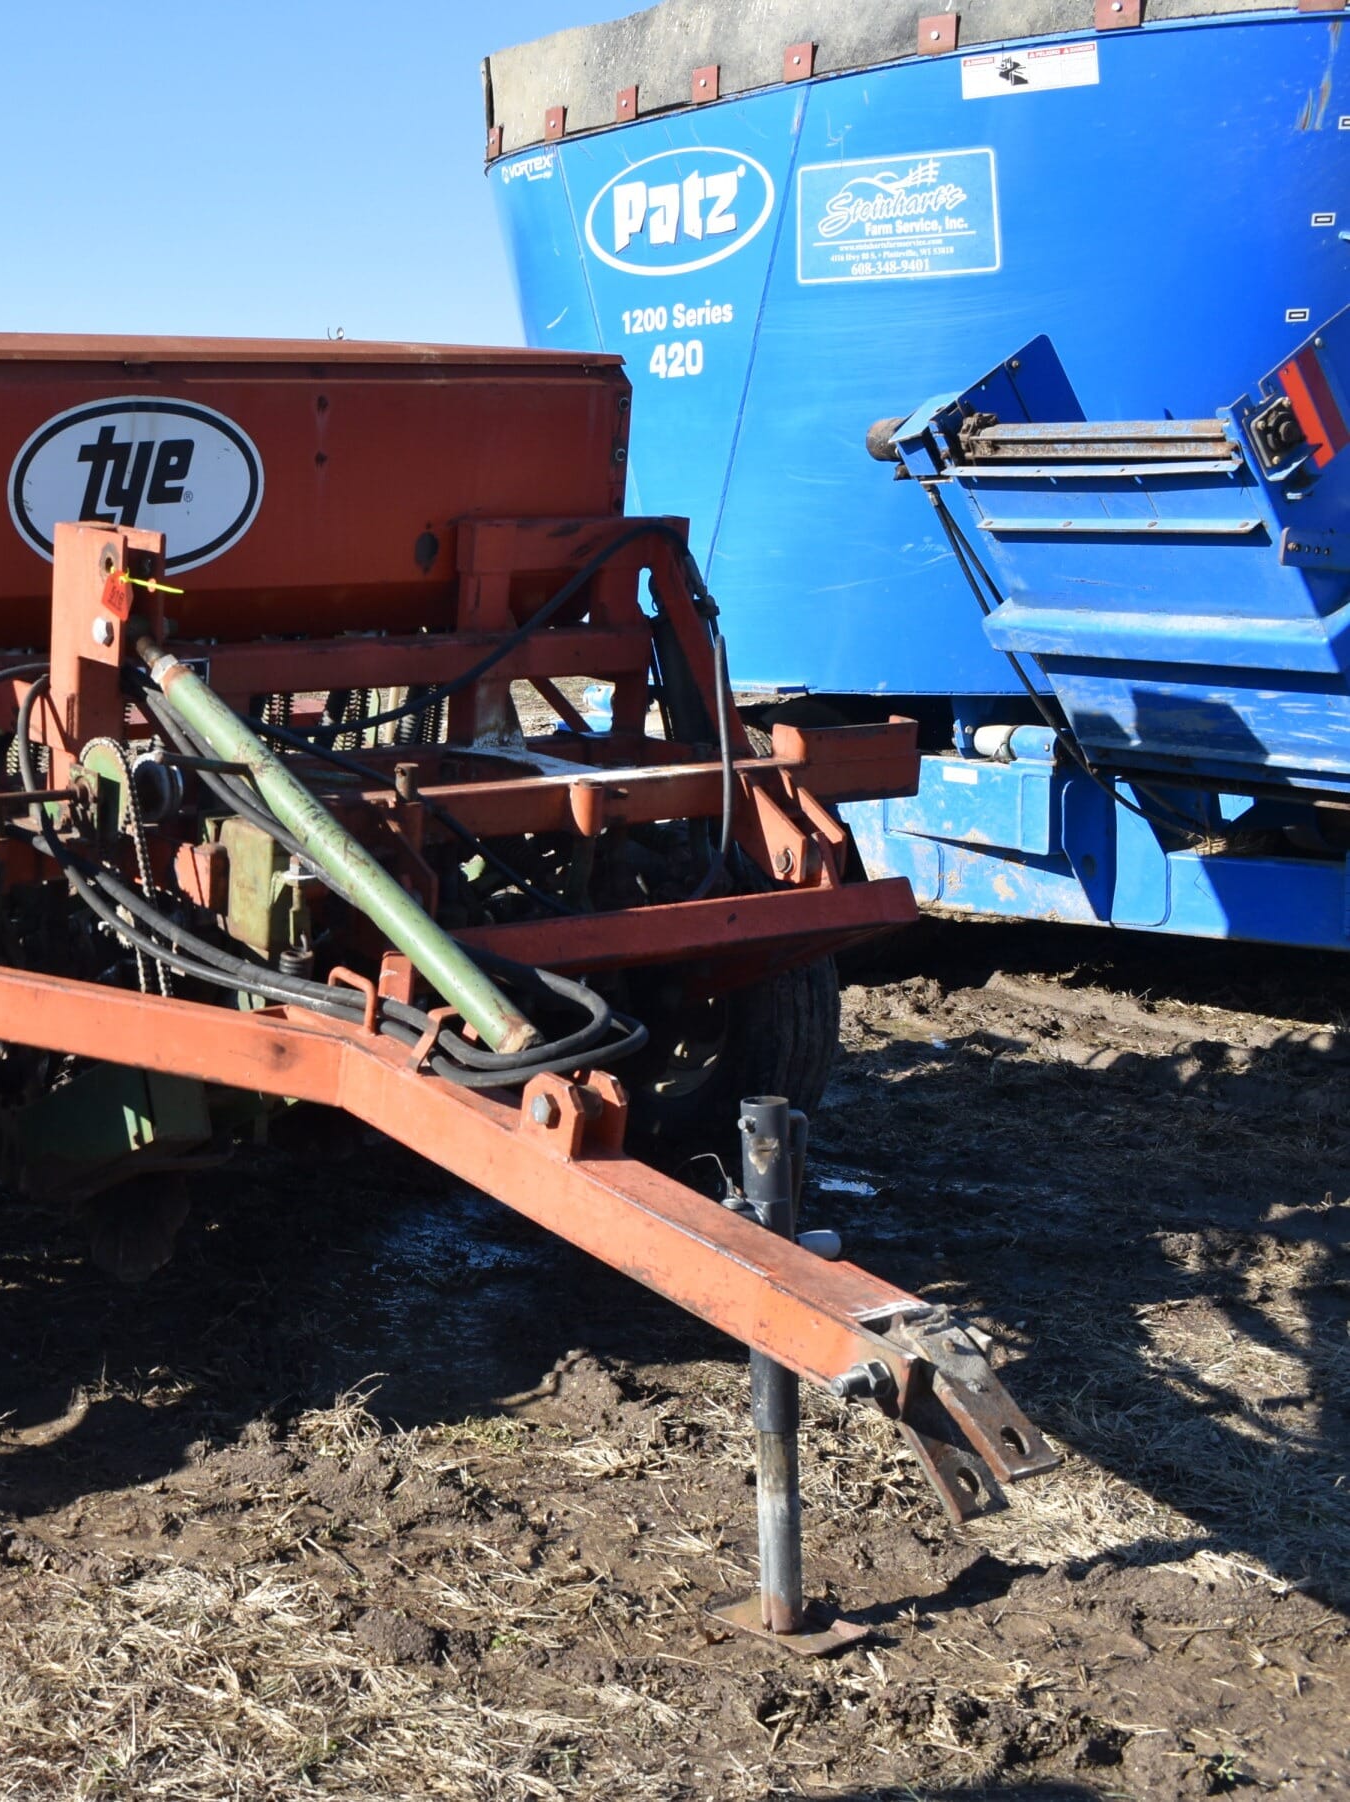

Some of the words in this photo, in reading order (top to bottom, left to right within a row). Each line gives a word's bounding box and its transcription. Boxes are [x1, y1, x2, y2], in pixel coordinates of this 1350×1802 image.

[508, 154, 554, 179] VORTEX
[818, 184, 967, 238] Steinhart's
[865, 221, 893, 237] Farm
[895, 217, 942, 235] Service,
[945, 215, 968, 230] Inc.
[851, 258, 930, 276] 608-348-9401
[622, 306, 667, 335] 1200
[672, 299, 734, 329] Series
[649, 340, 703, 379] 420
